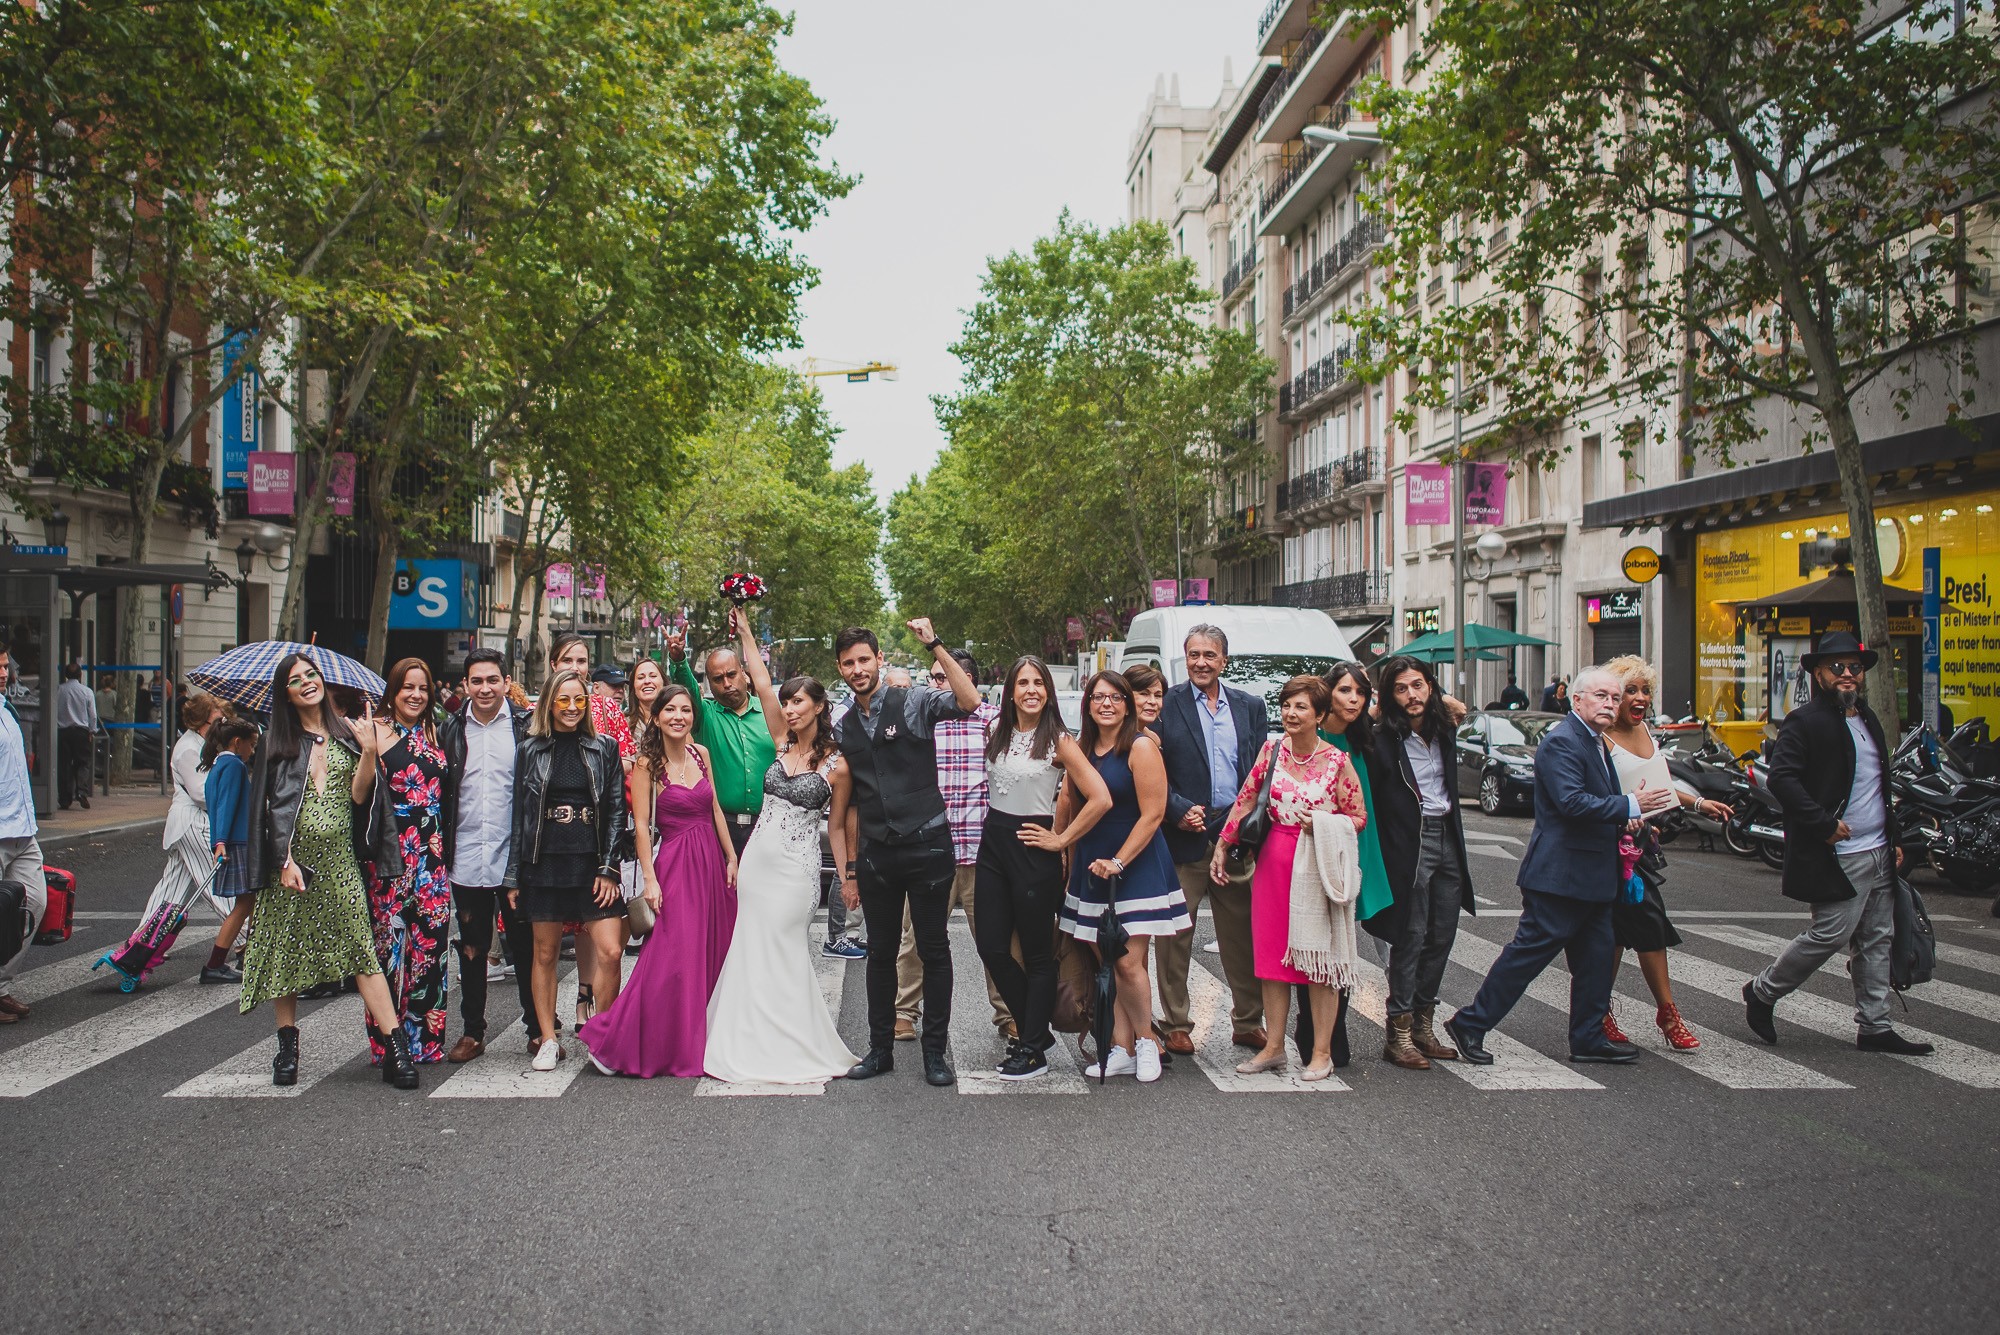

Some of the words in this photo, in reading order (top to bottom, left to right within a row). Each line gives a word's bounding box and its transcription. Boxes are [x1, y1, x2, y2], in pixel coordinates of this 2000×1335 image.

[244, 374, 252, 439] ALAMANCA
[1411, 480, 1445, 491] NAVES
[1625, 560, 1658, 570] pibank
[398, 576, 409, 590] B
[416, 576, 449, 618] S
[1945, 573, 1992, 608] Presi,
[1944, 639, 1955, 650] en
[1957, 636, 1980, 650] traer
[1944, 658, 1964, 676] aquí
[1944, 684, 1966, 699] para
